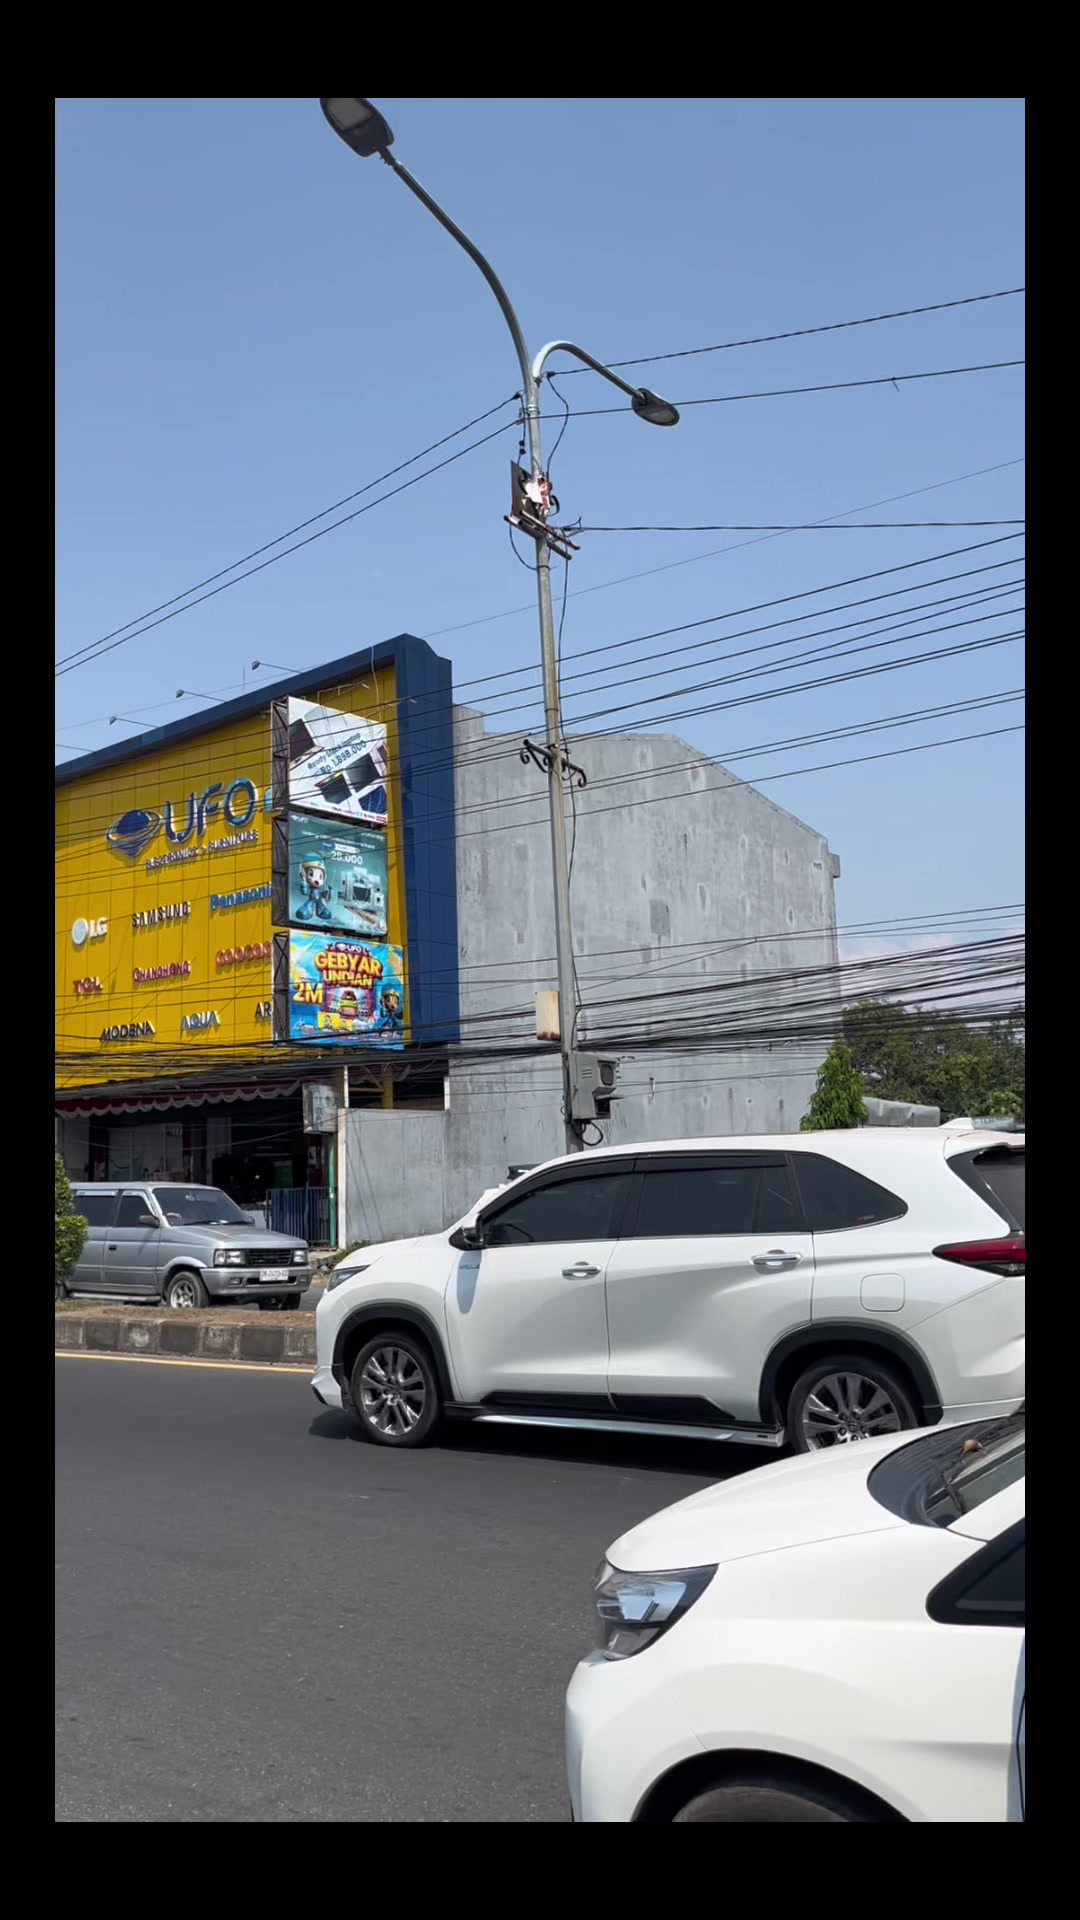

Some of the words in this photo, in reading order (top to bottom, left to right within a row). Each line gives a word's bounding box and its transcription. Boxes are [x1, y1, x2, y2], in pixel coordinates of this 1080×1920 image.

[164, 777, 259, 843] UFO
[132, 901, 190, 928] SAMSUNG
[89, 917, 108, 938] LG
[315, 952, 382, 977] GEBYAR
[73, 976, 103, 993] TCL
[323, 970, 373, 989] UNDIAN
[293, 981, 324, 1005] 2M
[180, 1010, 220, 1031] AQUA
[101, 1021, 156, 1042] MODENA
